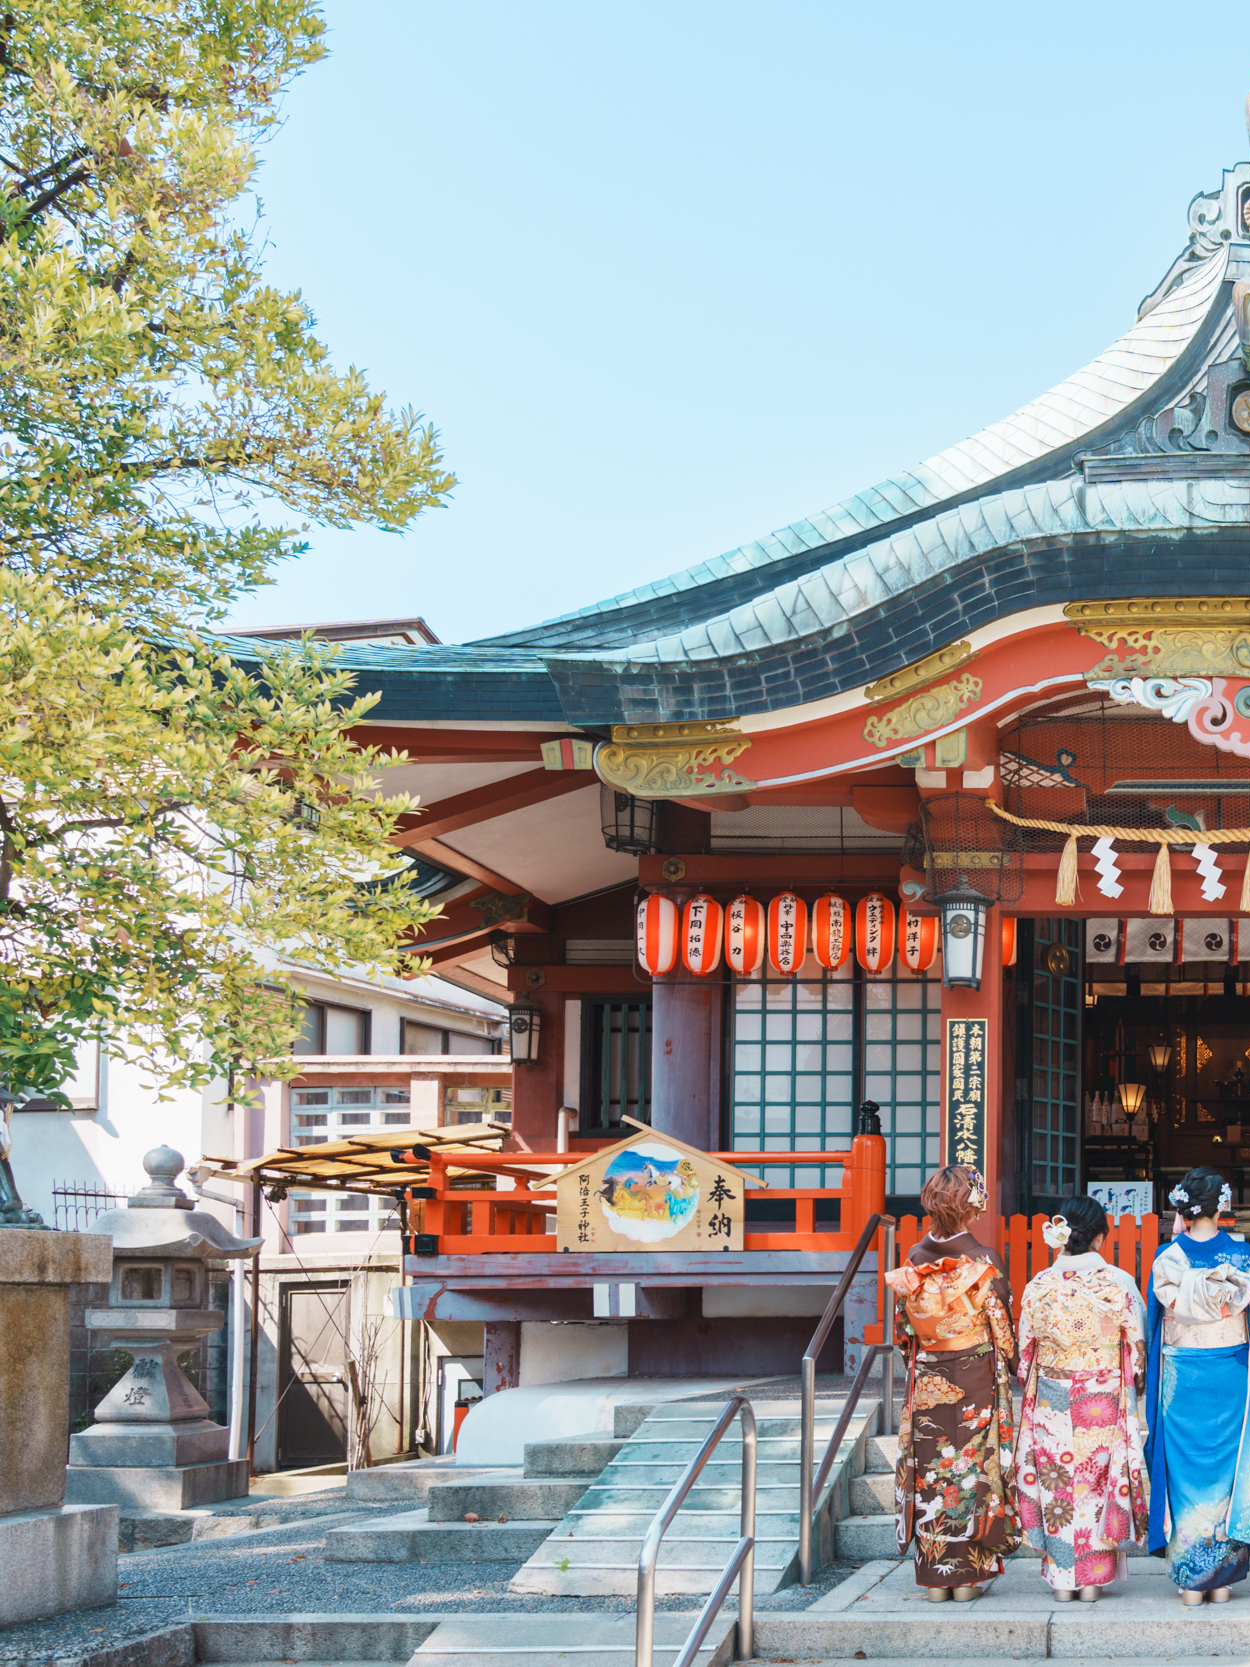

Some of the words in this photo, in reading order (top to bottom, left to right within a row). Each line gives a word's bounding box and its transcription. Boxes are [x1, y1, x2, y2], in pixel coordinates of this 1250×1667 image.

[907, 911, 920, 957] 村洋子
[578, 1174, 590, 1243] 阿倍王子神社
[707, 1175, 737, 1238] 奉納
